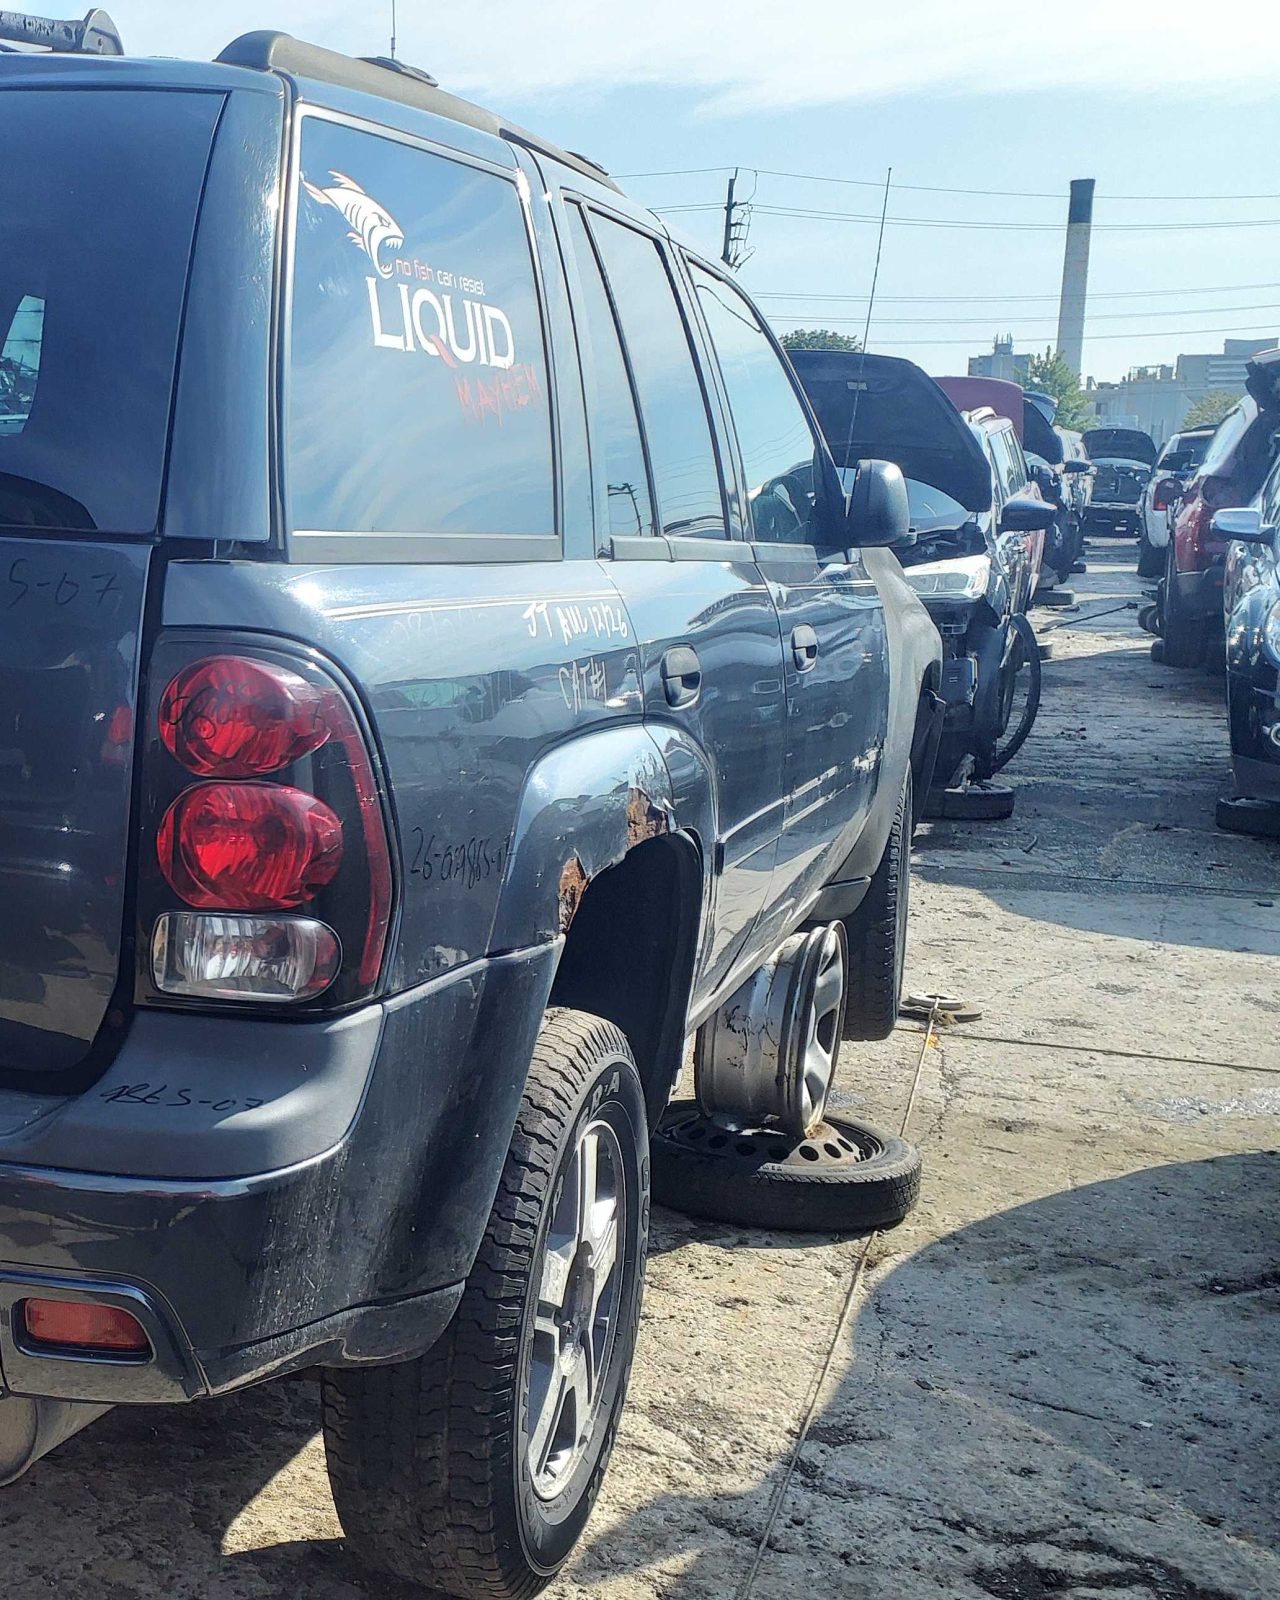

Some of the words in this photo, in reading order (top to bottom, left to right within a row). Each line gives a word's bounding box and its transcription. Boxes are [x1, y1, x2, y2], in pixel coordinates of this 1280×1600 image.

[395, 259, 412, 277] no
[413, 259, 435, 283] fish
[436, 269, 458, 289] can
[365, 276, 516, 370] LIQUID
[452, 363, 542, 430] MAYHEM
